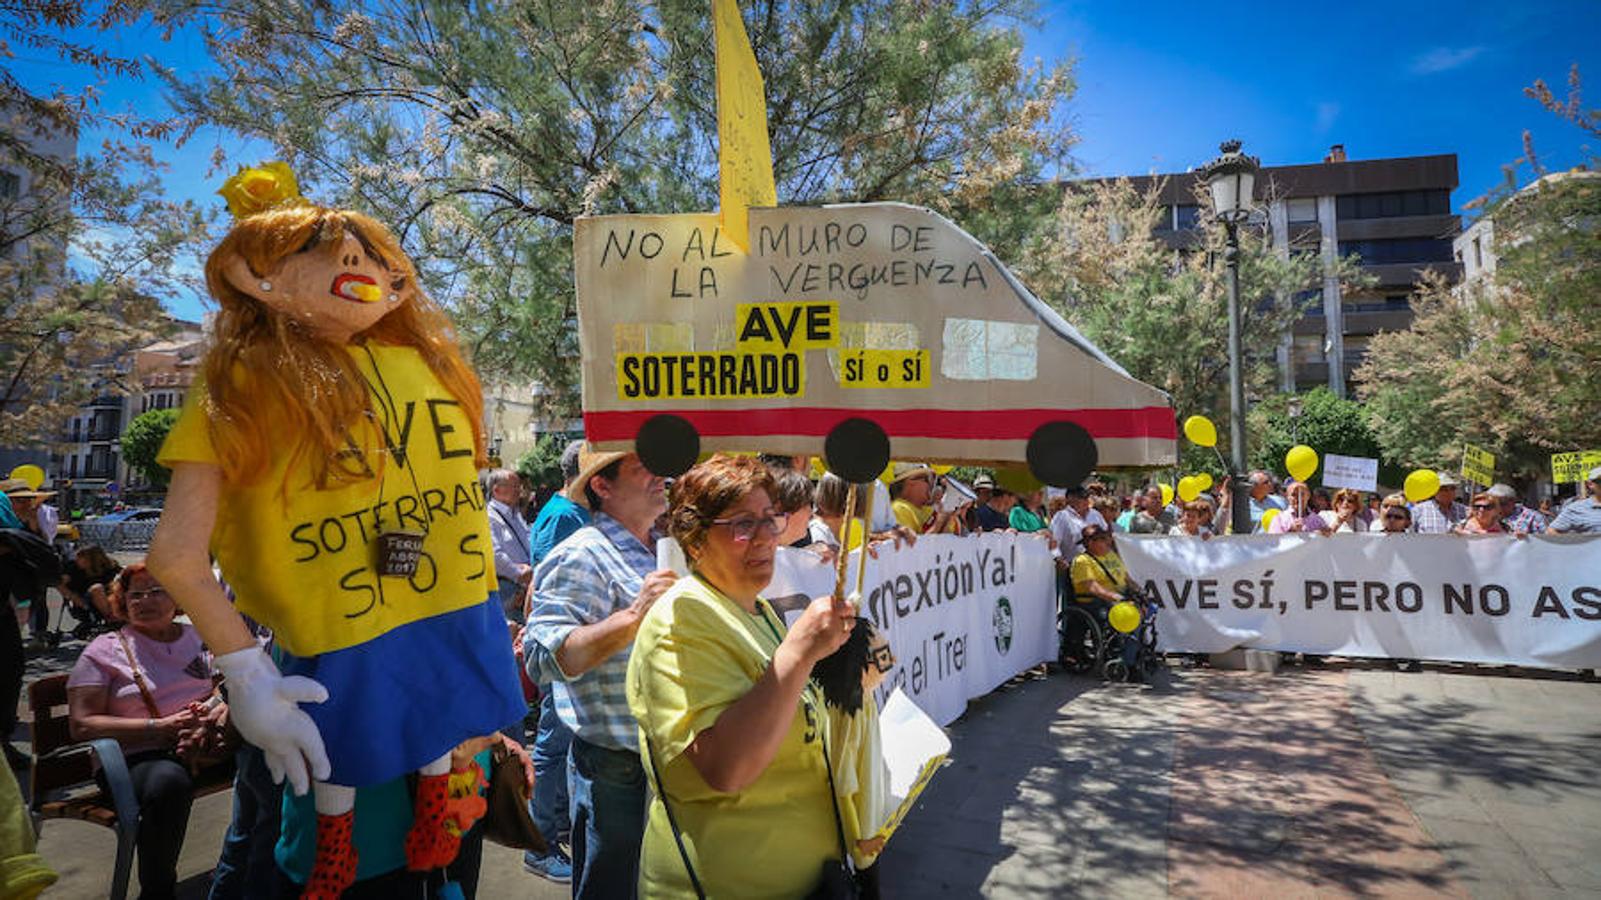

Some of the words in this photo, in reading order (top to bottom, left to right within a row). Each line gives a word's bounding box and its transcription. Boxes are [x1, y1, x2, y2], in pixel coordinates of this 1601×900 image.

[600, 229, 665, 268] NO
[683, 227, 733, 262] AL
[759, 223, 868, 257] MURO
[891, 225, 936, 252] DE
[671, 266, 719, 299] LA
[770, 258, 988, 300] VERGUENZA
[739, 305, 831, 350] AVE
[623, 352, 800, 397] SOTERRADO
[845, 351, 865, 382] SÍ
[877, 364, 889, 382] o
[902, 351, 922, 382] SÍ
[976, 545, 1016, 590] Ya!
[1143, 579, 1219, 609] AVE
[1232, 569, 1287, 615] SÍ,
[1304, 580, 1423, 613] PERO
[1442, 583, 1511, 616] NO
[1532, 586, 1601, 620] AS
[912, 640, 928, 696] el
